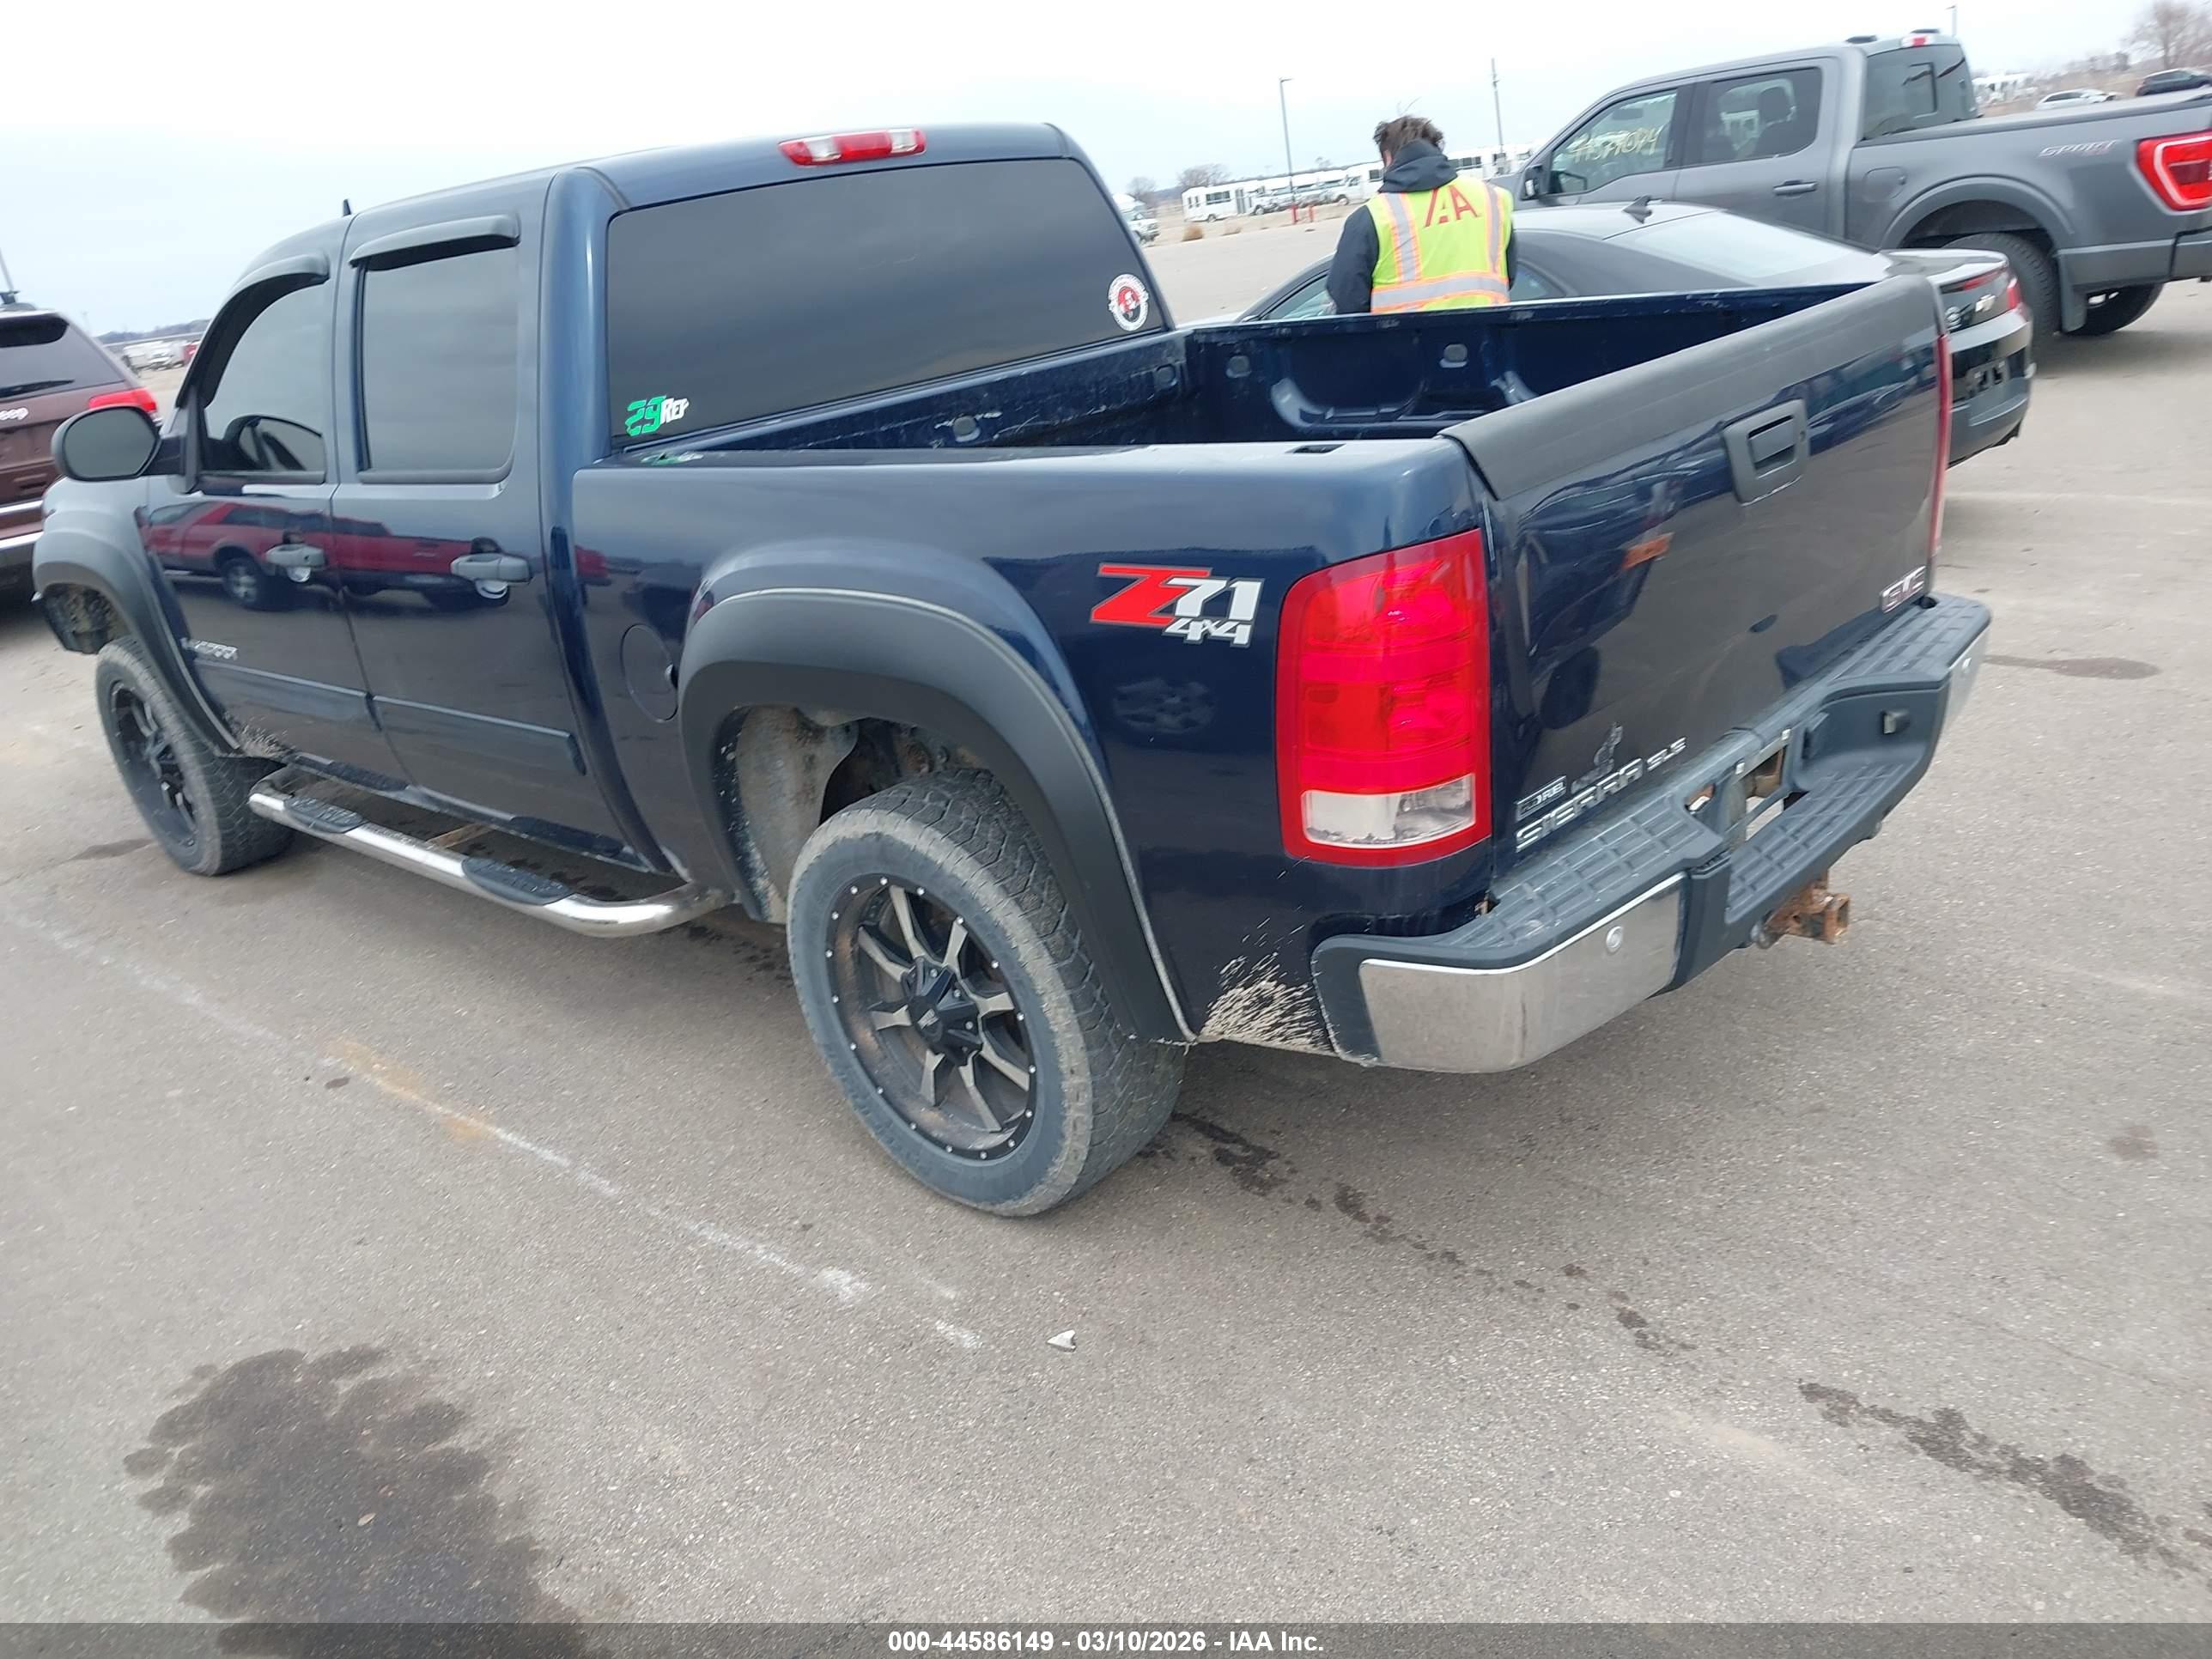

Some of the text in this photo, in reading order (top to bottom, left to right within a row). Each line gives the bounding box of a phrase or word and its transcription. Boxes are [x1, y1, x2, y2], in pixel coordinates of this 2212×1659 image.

[0, 408, 28, 421] eep
[1090, 563, 1264, 628] Z71
[1516, 757, 1643, 853] SIERRA
